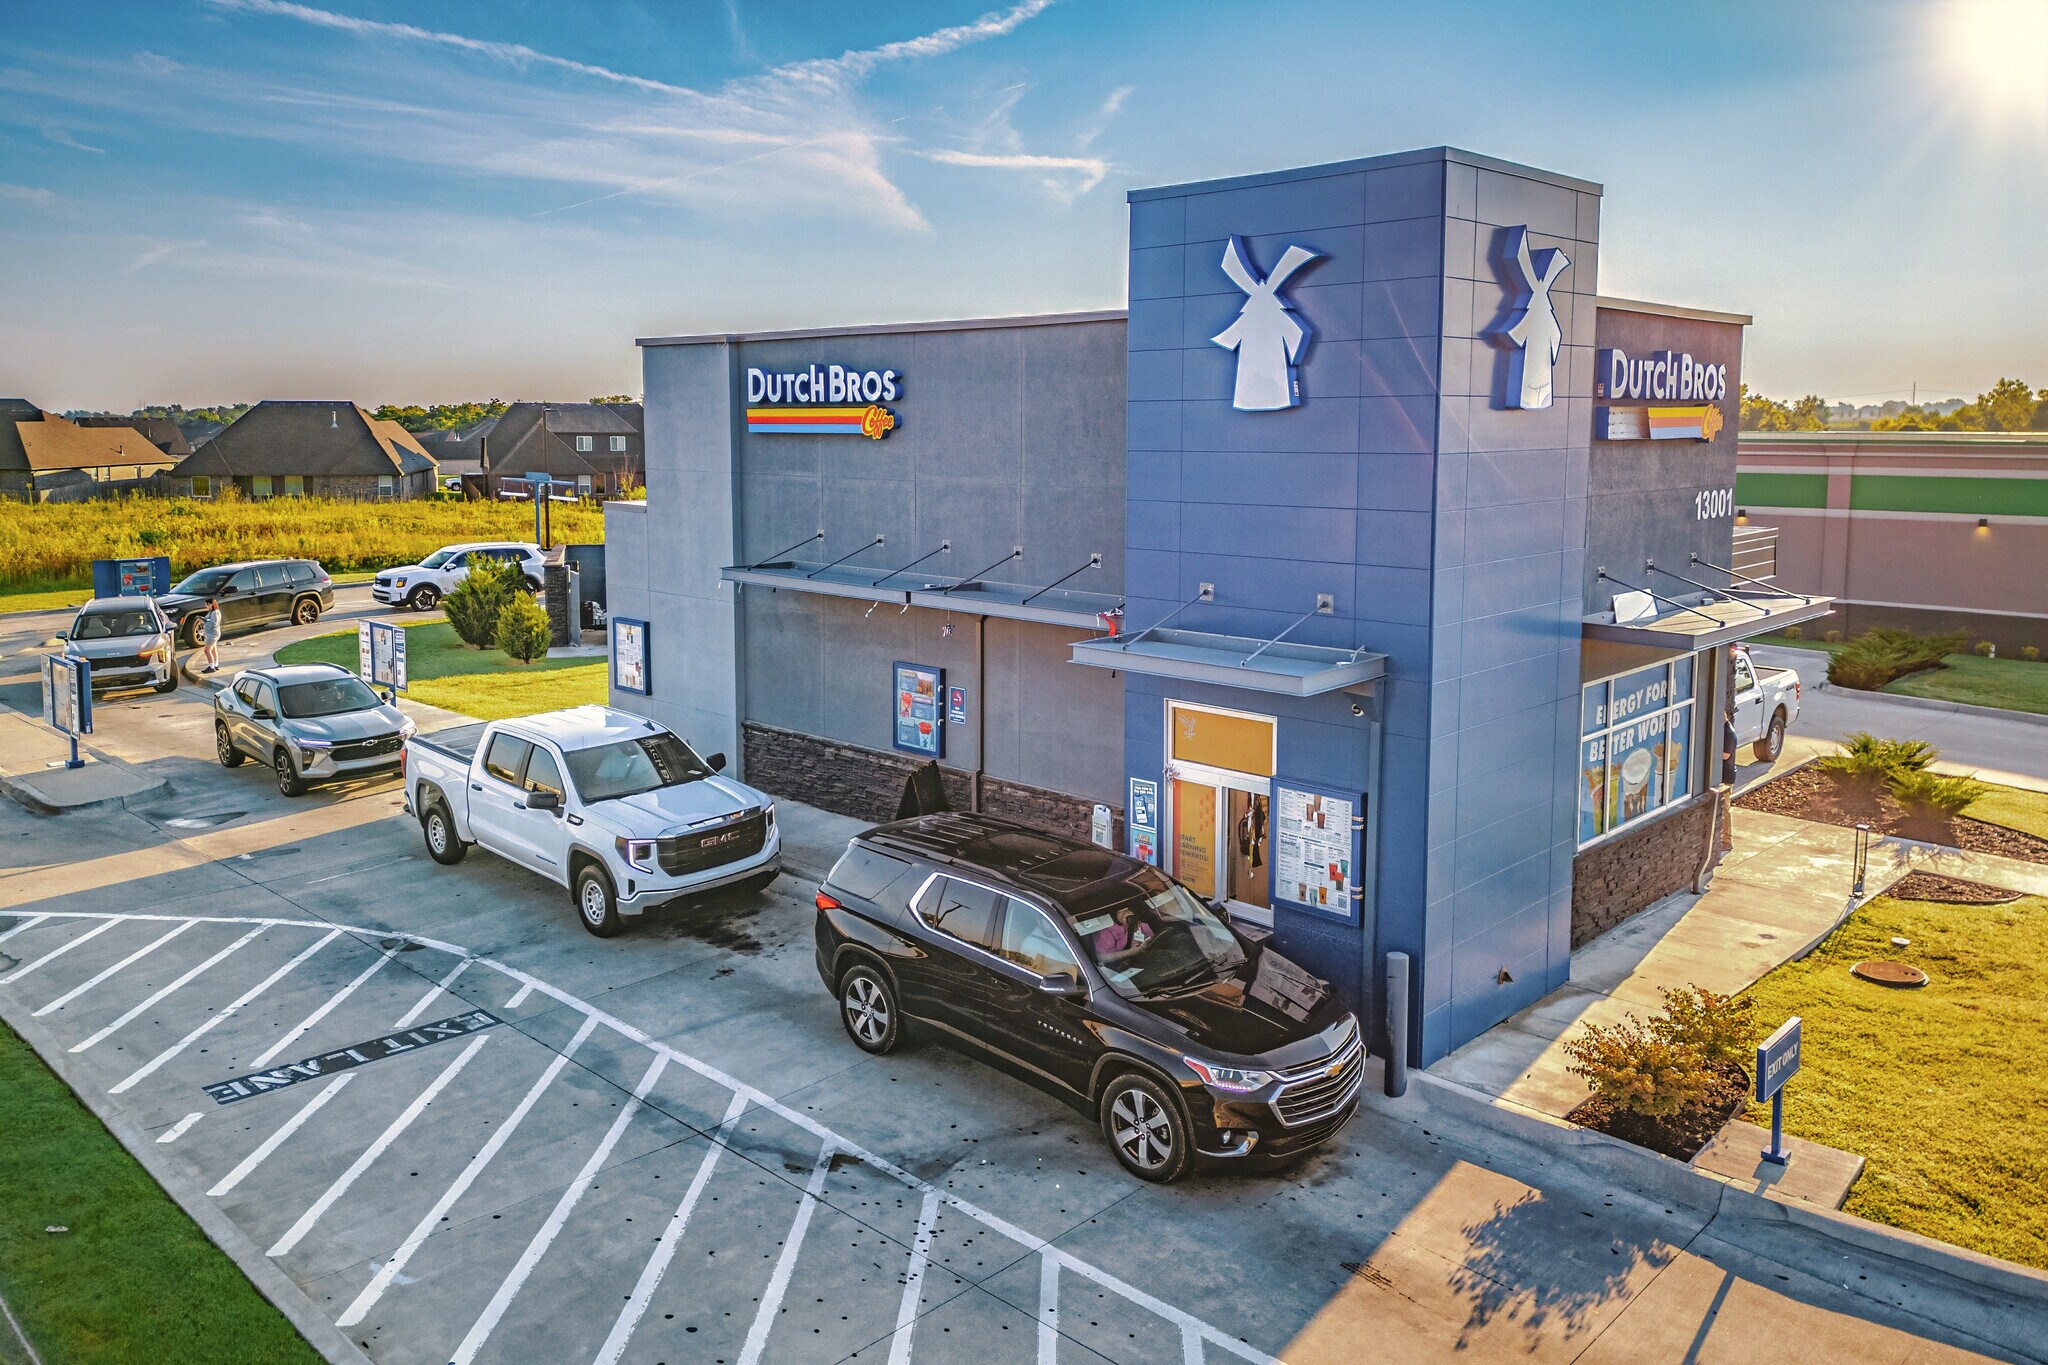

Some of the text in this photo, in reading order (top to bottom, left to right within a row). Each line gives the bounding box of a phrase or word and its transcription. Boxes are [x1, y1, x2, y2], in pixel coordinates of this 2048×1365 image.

[829, 364, 897, 403] BROS
[1680, 353, 1727, 401] BROS
[861, 404, 895, 440] Coffee
[1695, 488, 1734, 521] 13001
[1644, 680, 1668, 706] FOR
[1589, 710, 1681, 763] BETER WORD
[701, 830, 740, 848] GMC
[384, 1011, 497, 1055] EXIT
[1767, 1041, 1799, 1081] EXIT ONLY
